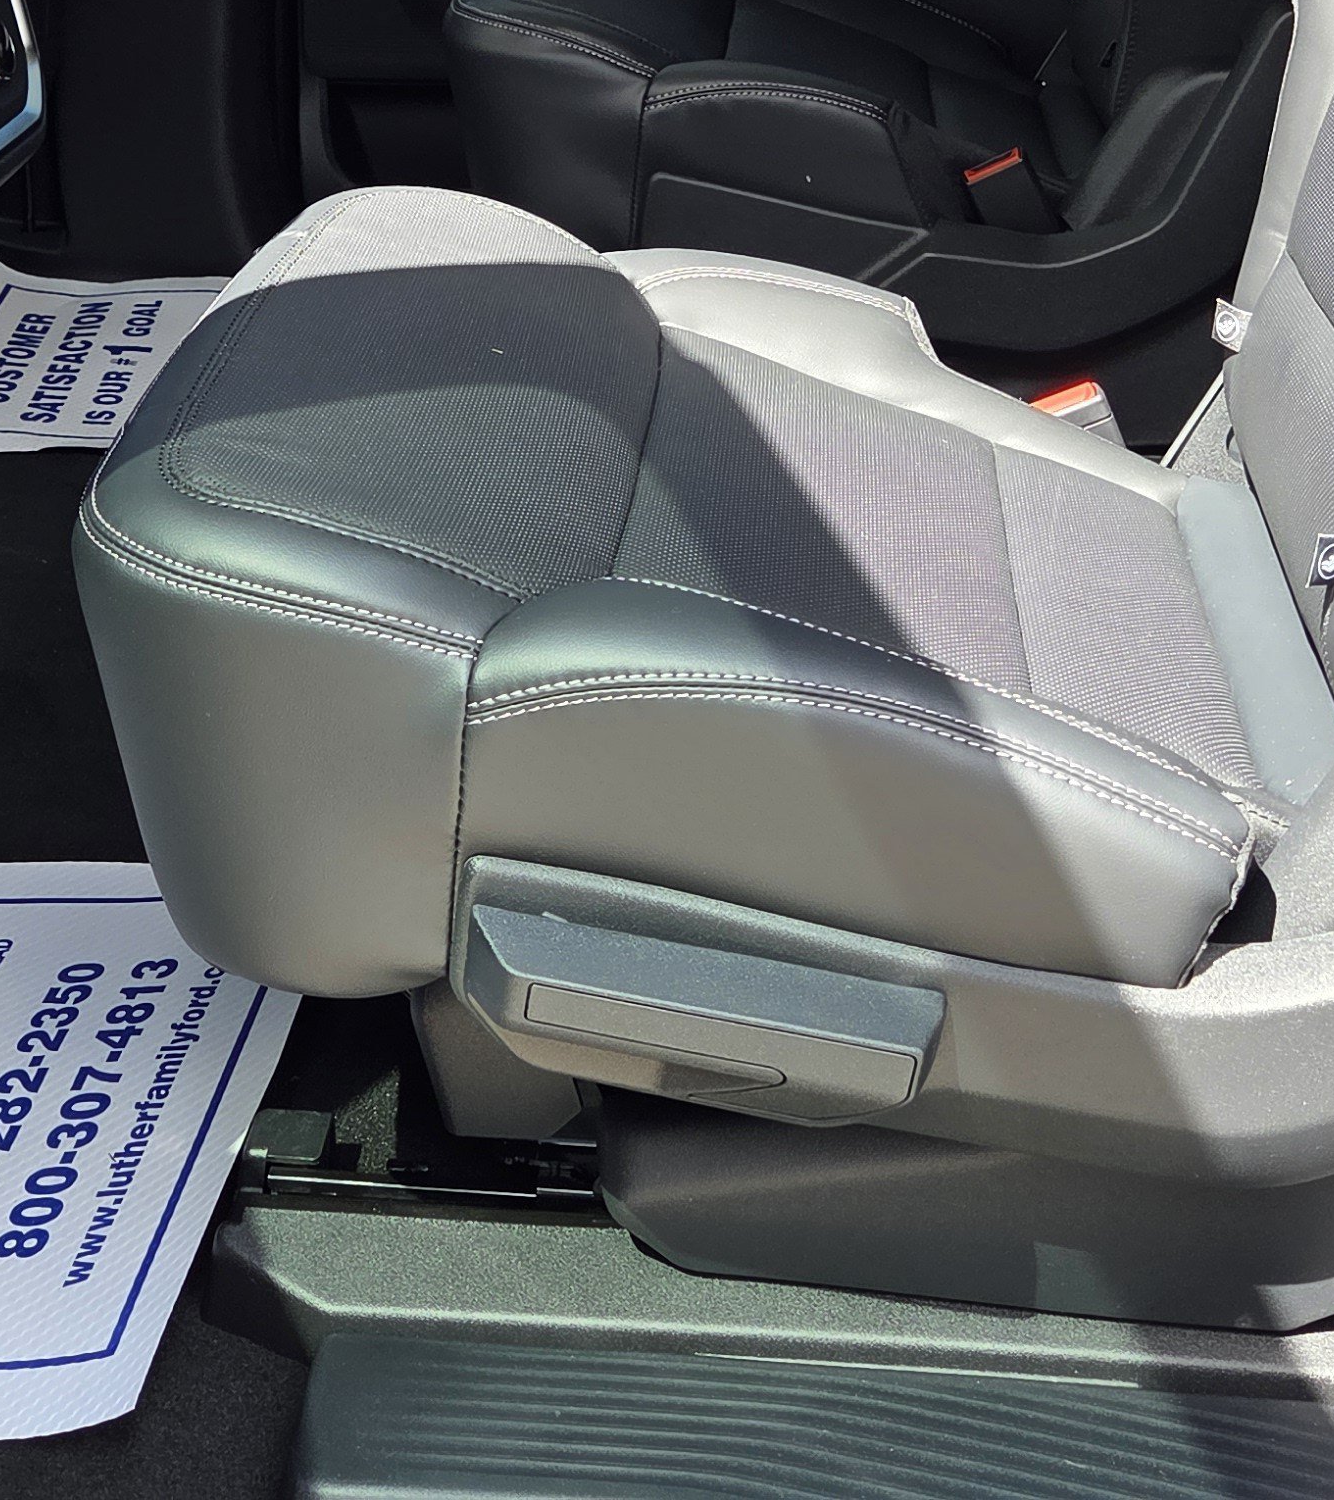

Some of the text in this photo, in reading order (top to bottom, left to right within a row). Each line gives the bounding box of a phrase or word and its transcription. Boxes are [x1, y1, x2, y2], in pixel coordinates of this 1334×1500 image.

[20, 301, 113, 423] SATISFACTION
[82, 300, 163, 425] IS OUR #1 GOAL
[62, 966, 225, 1288] www.lutherfamilyford.c
